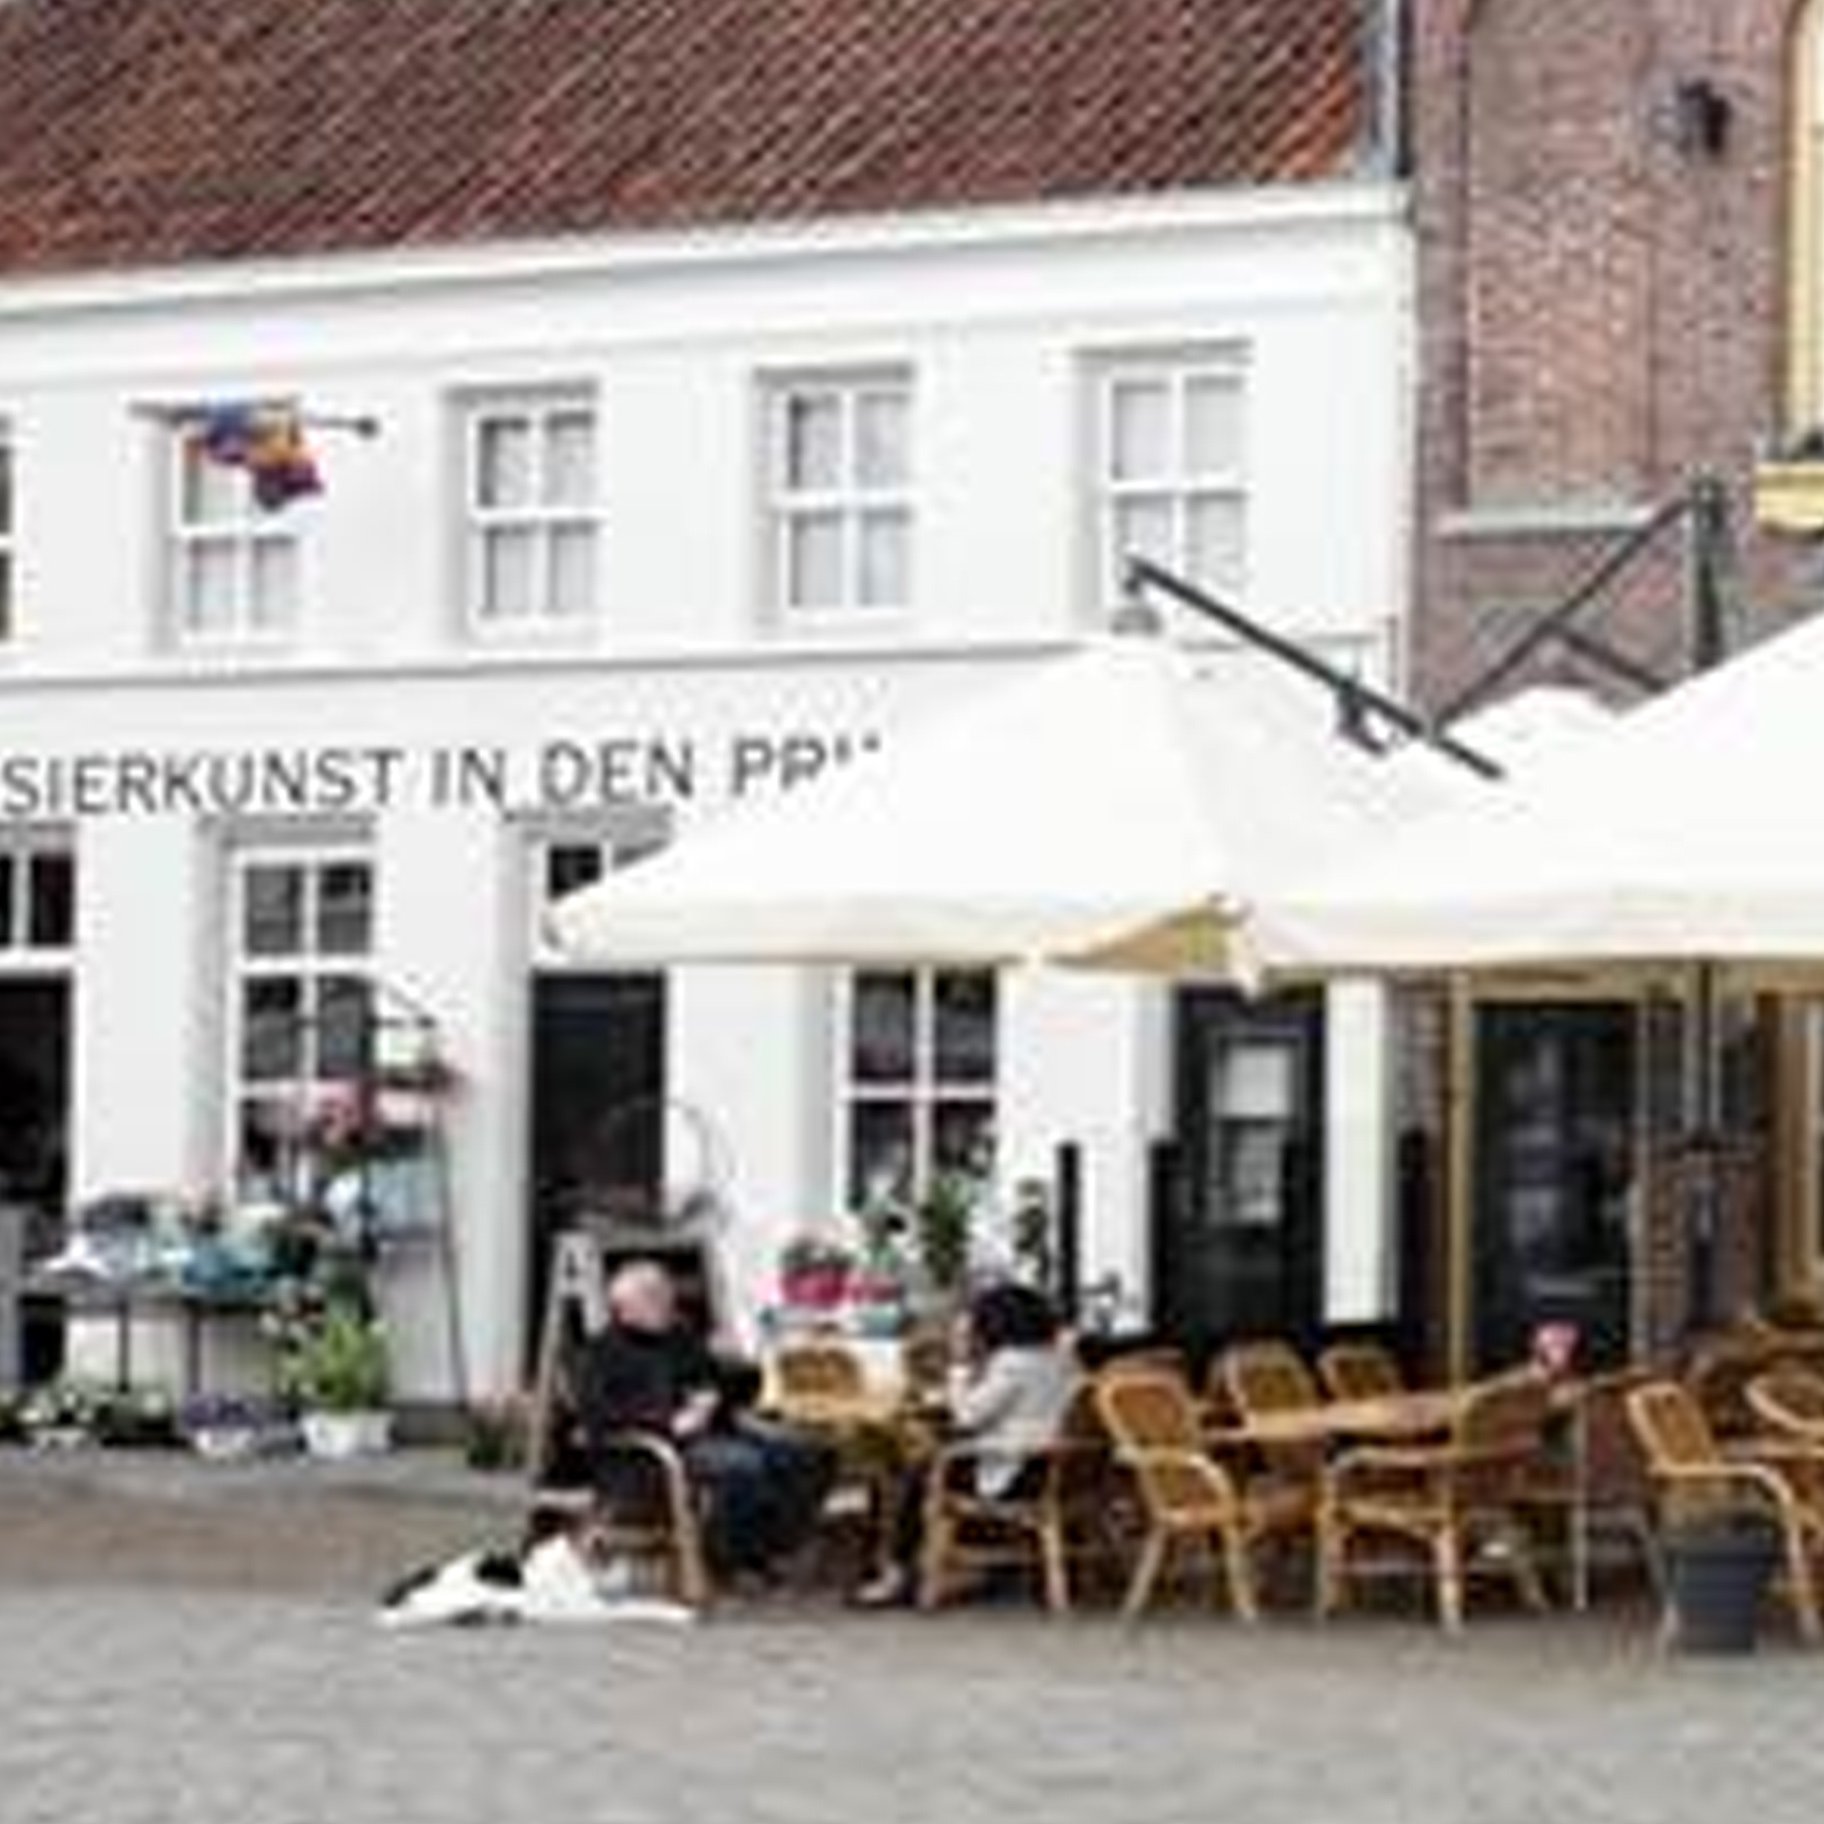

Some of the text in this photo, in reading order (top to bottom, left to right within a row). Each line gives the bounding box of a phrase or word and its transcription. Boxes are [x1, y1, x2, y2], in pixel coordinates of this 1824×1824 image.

[1, 749, 406, 814] SIERKUNST
[431, 747, 506, 808] IN
[541, 738, 693, 806] DEN
